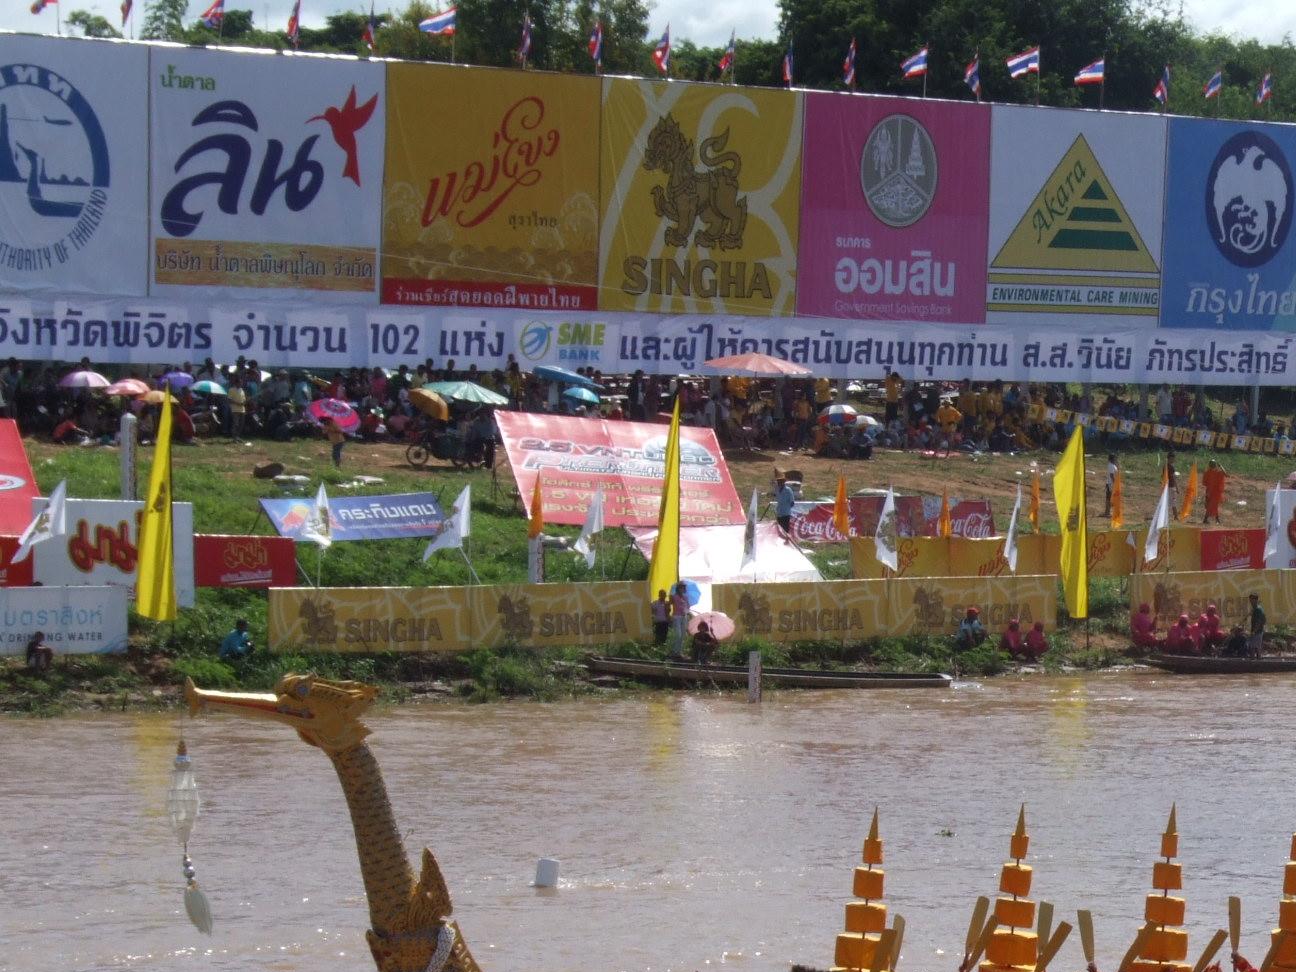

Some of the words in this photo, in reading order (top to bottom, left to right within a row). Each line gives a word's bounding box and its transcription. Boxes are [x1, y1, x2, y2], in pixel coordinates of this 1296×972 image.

[160, 66, 216, 91] น้ำตาล
[161, 100, 324, 237] ลิน
[1032, 159, 1086, 245] Akara
[0, 241, 51, 272] THORITY
[54, 239, 69, 264] OF
[67, 188, 108, 251] THAILAND
[836, 237, 872, 249] ธนาคาร
[157, 248, 202, 271] บริษัท
[208, 243, 326, 282] น้ำตาลพิษณุโลก
[334, 256, 374, 278] จำกัด
[835, 250, 956, 297] ออมสิน
[621, 255, 772, 299] SINGHA
[992, 287, 1083, 303] ENVIRONMENTAL
[1087, 290, 1114, 304] CARE
[1119, 290, 1159, 305] MINING
[233, 312, 347, 353] จำนวน
[370, 322, 420, 355] 102
[439, 320, 505, 357] แห่ง
[557, 322, 606, 347] SME
[559, 349, 600, 362] BANK
[338, 503, 438, 521] กระทิงแดง
[68, 510, 140, 574] มาม
[344, 618, 443, 643] SINGHA
[539, 611, 628, 637] SINGHA
[778, 608, 864, 633] SINGHA
[68, 631, 103, 641] WATER
